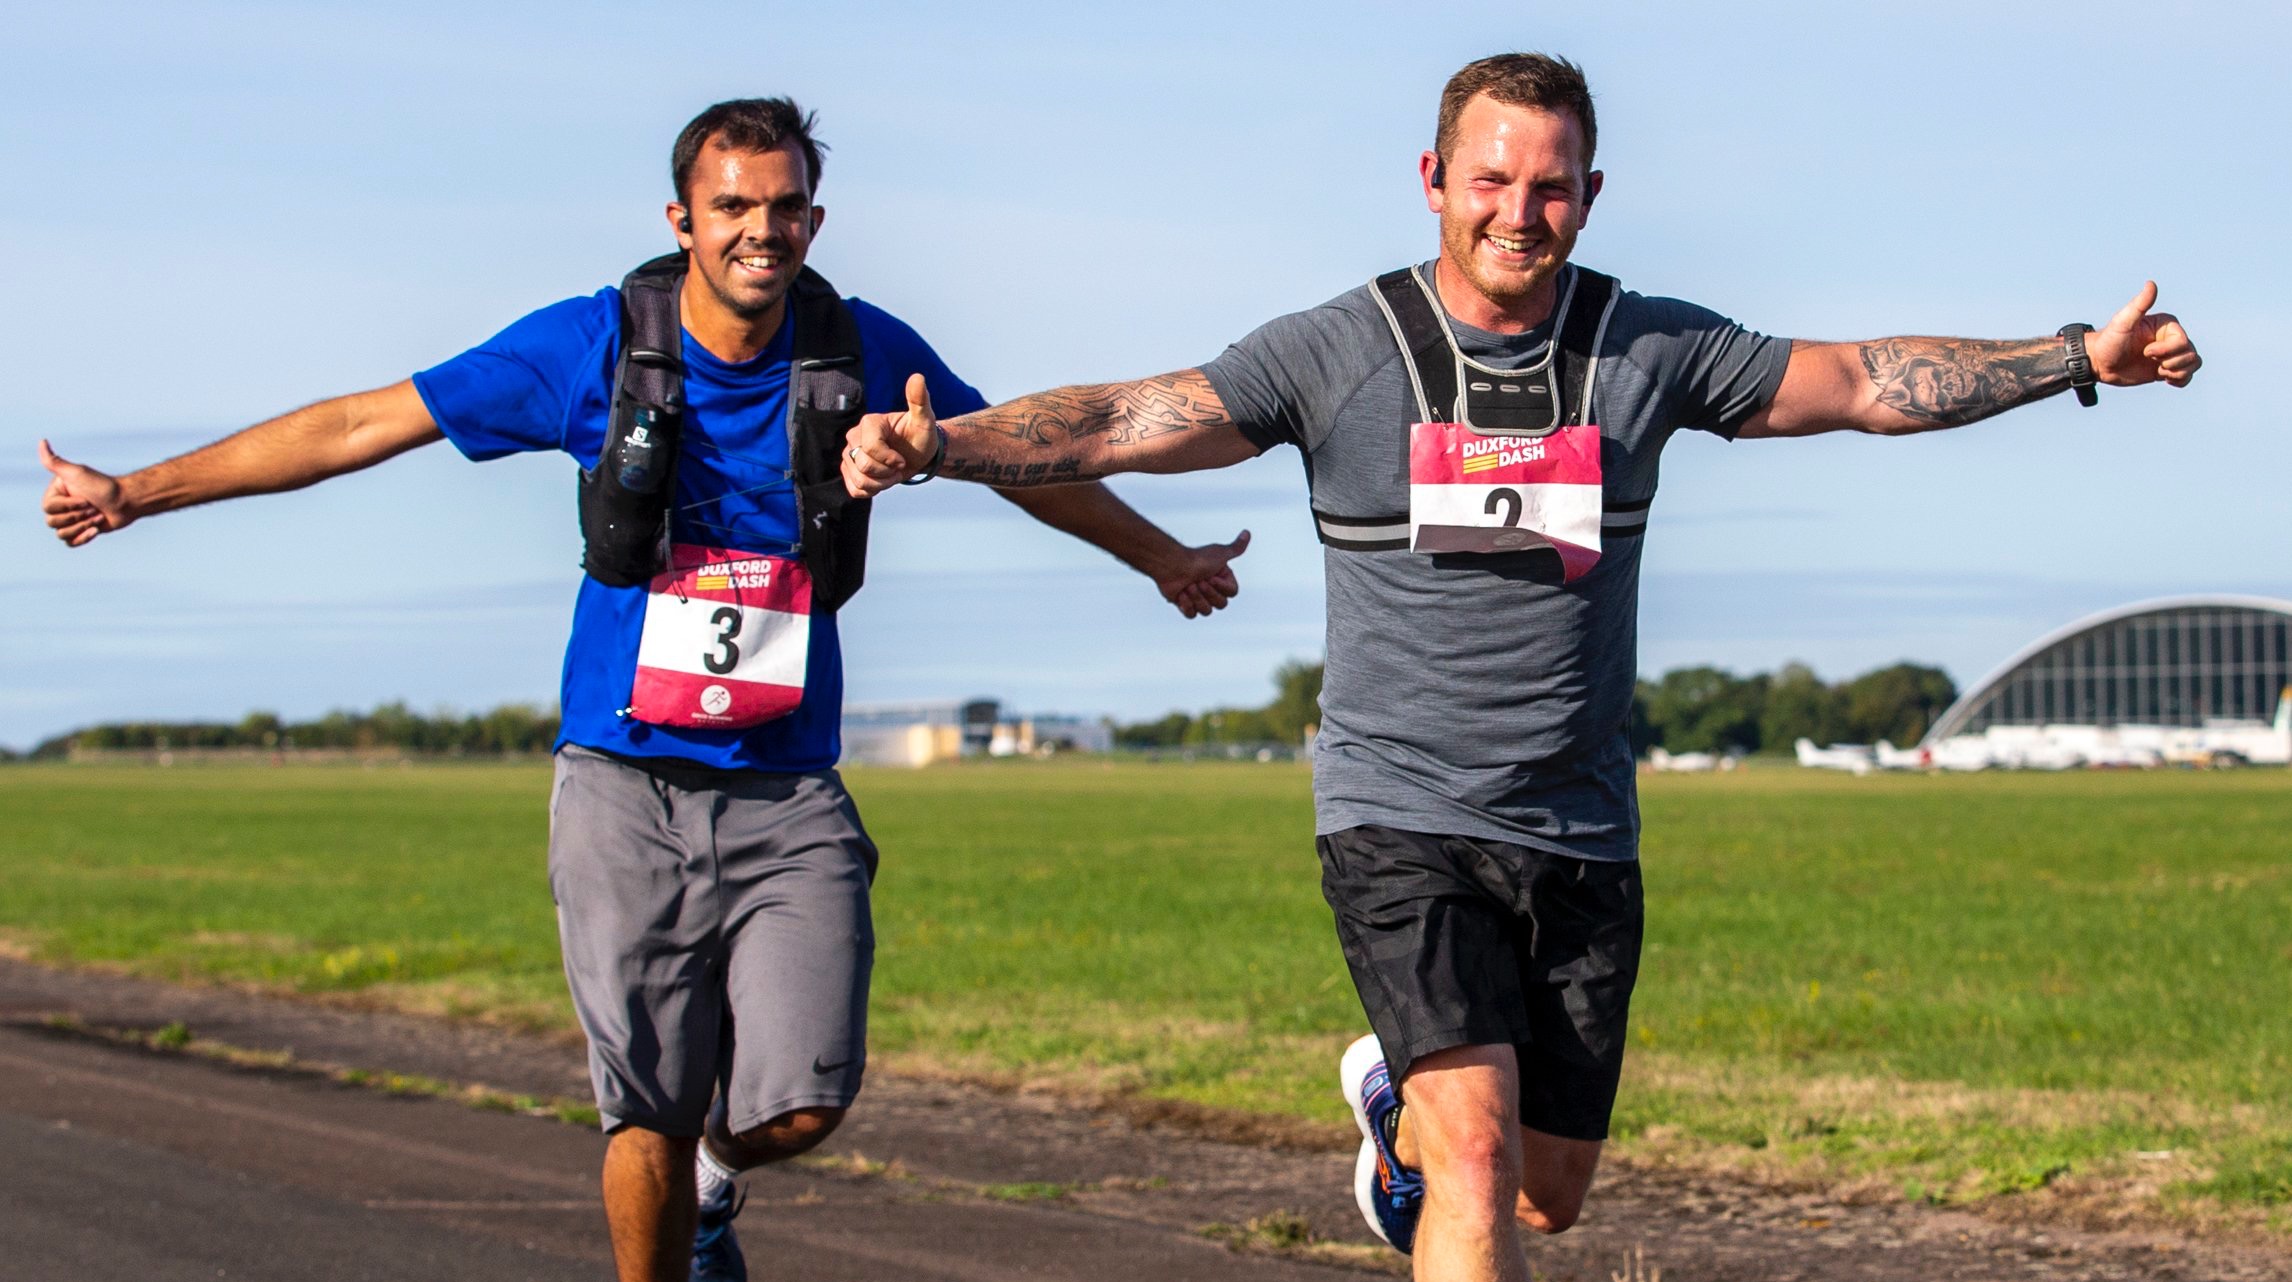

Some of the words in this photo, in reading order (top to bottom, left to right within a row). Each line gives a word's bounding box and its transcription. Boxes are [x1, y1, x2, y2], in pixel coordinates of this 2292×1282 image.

[1498, 444, 1545, 467] DASH
[1484, 487, 1523, 529] 2
[727, 574, 771, 589] DASH
[703, 606, 743, 675] 3
